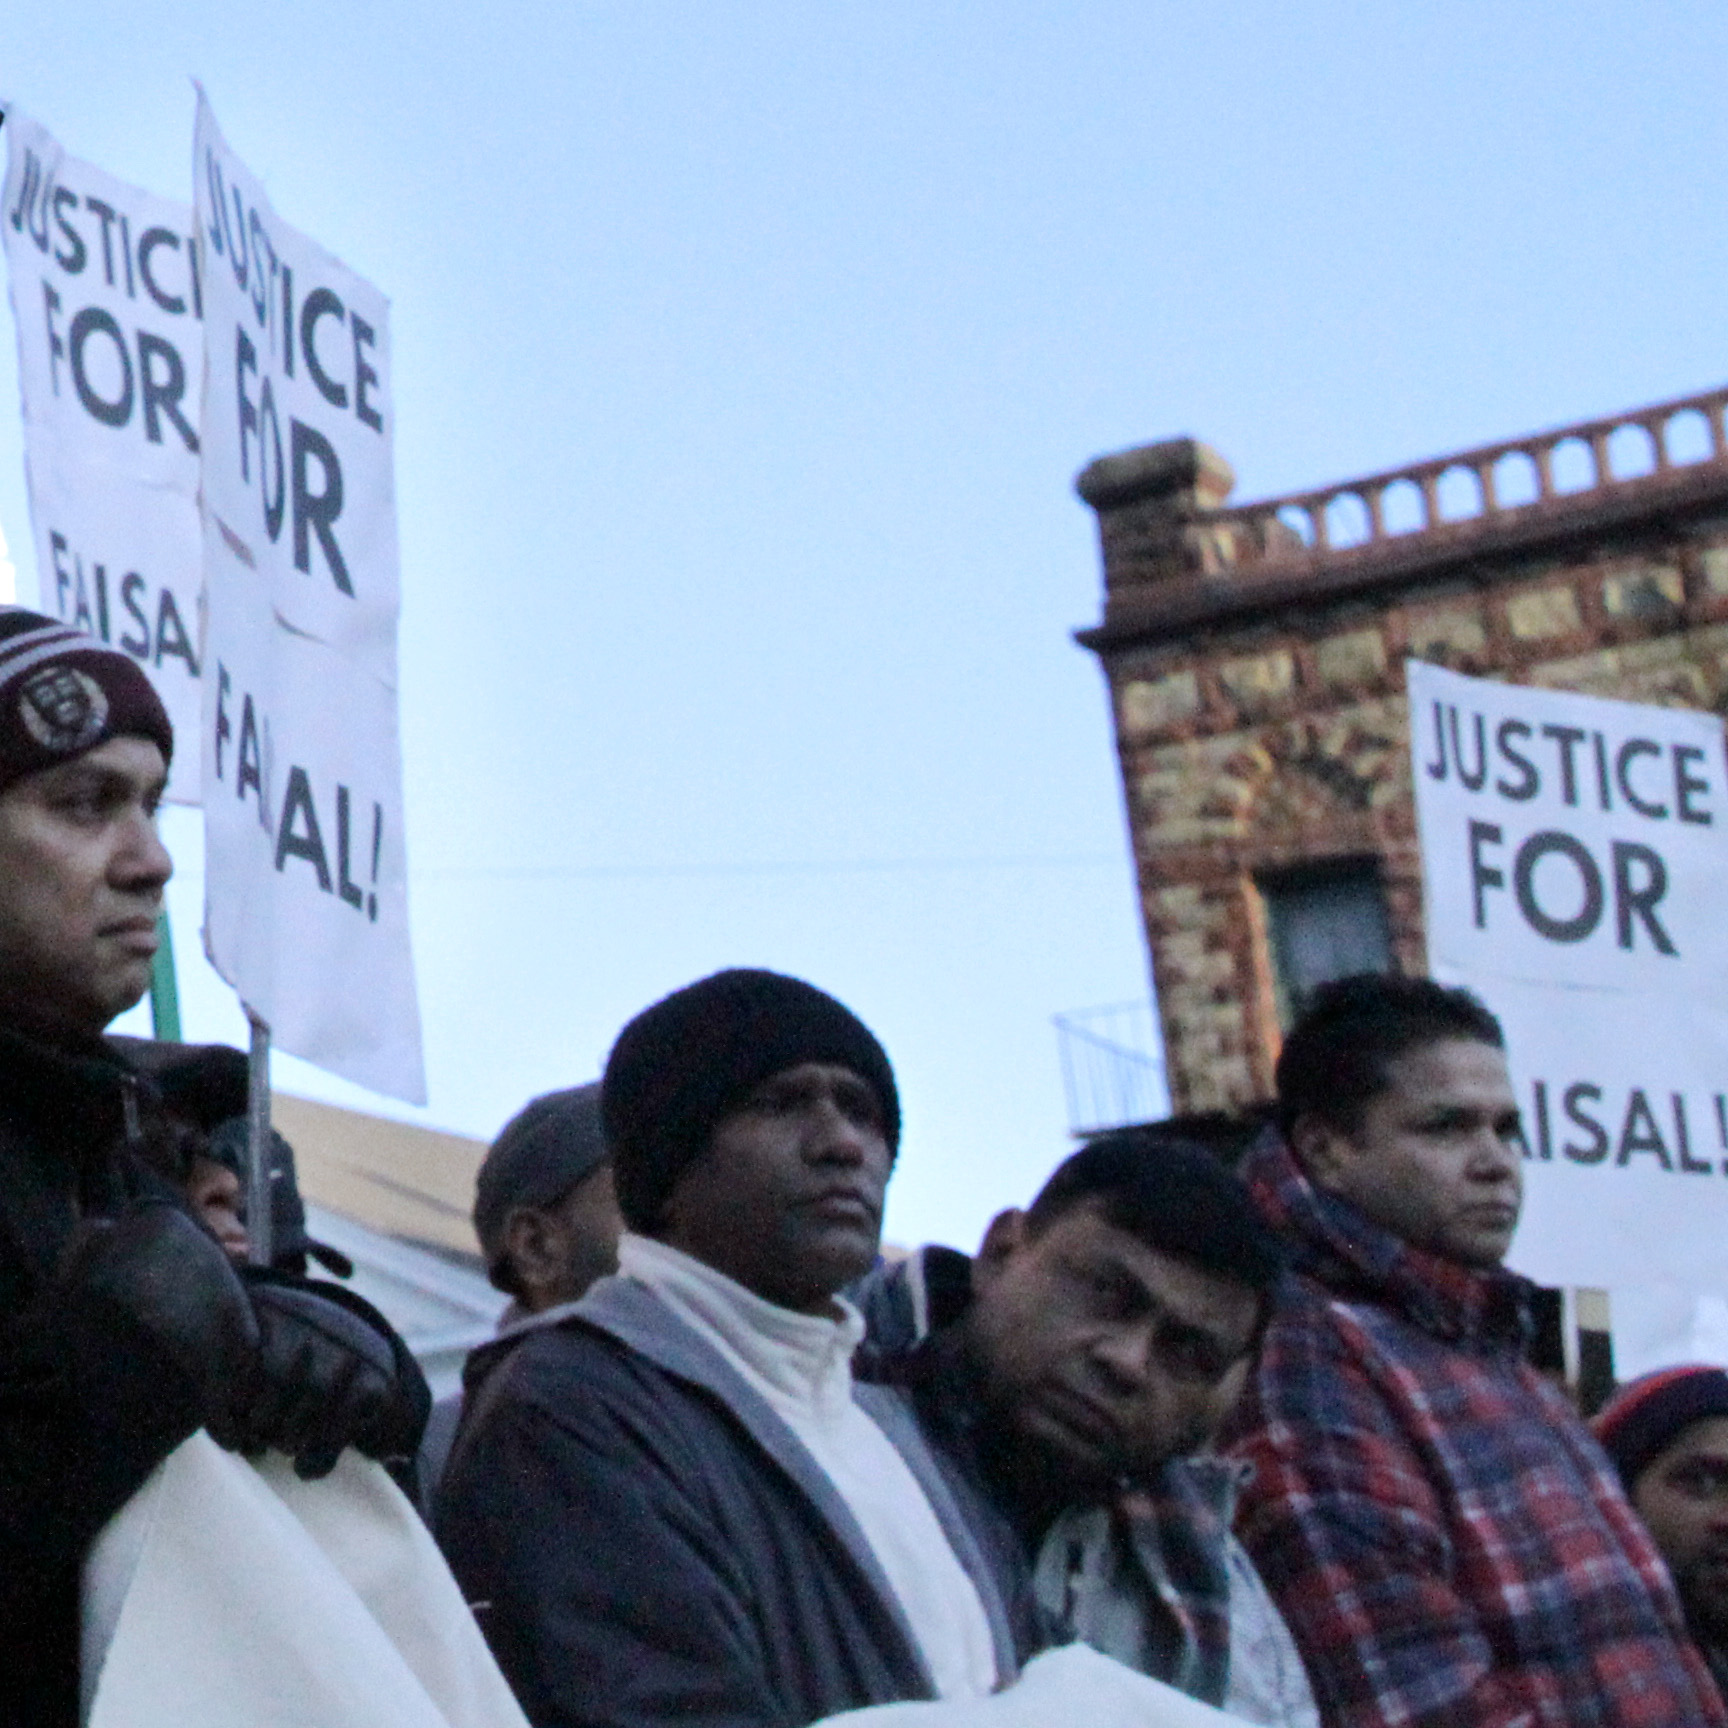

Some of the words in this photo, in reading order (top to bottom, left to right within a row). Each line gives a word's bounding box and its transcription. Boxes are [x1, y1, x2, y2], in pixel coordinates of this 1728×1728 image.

[42, 276, 200, 456] FOR
[205, 144, 384, 435] JUSTICE
[234, 322, 355, 598] FOR
[48, 528, 202, 678] FAISA
[215, 658, 383, 923] FAIAL!
[1425, 700, 1713, 827] JUSTICE
[1467, 818, 1680, 958] FOR
[1517, 1078, 1728, 1179] ISAL!
